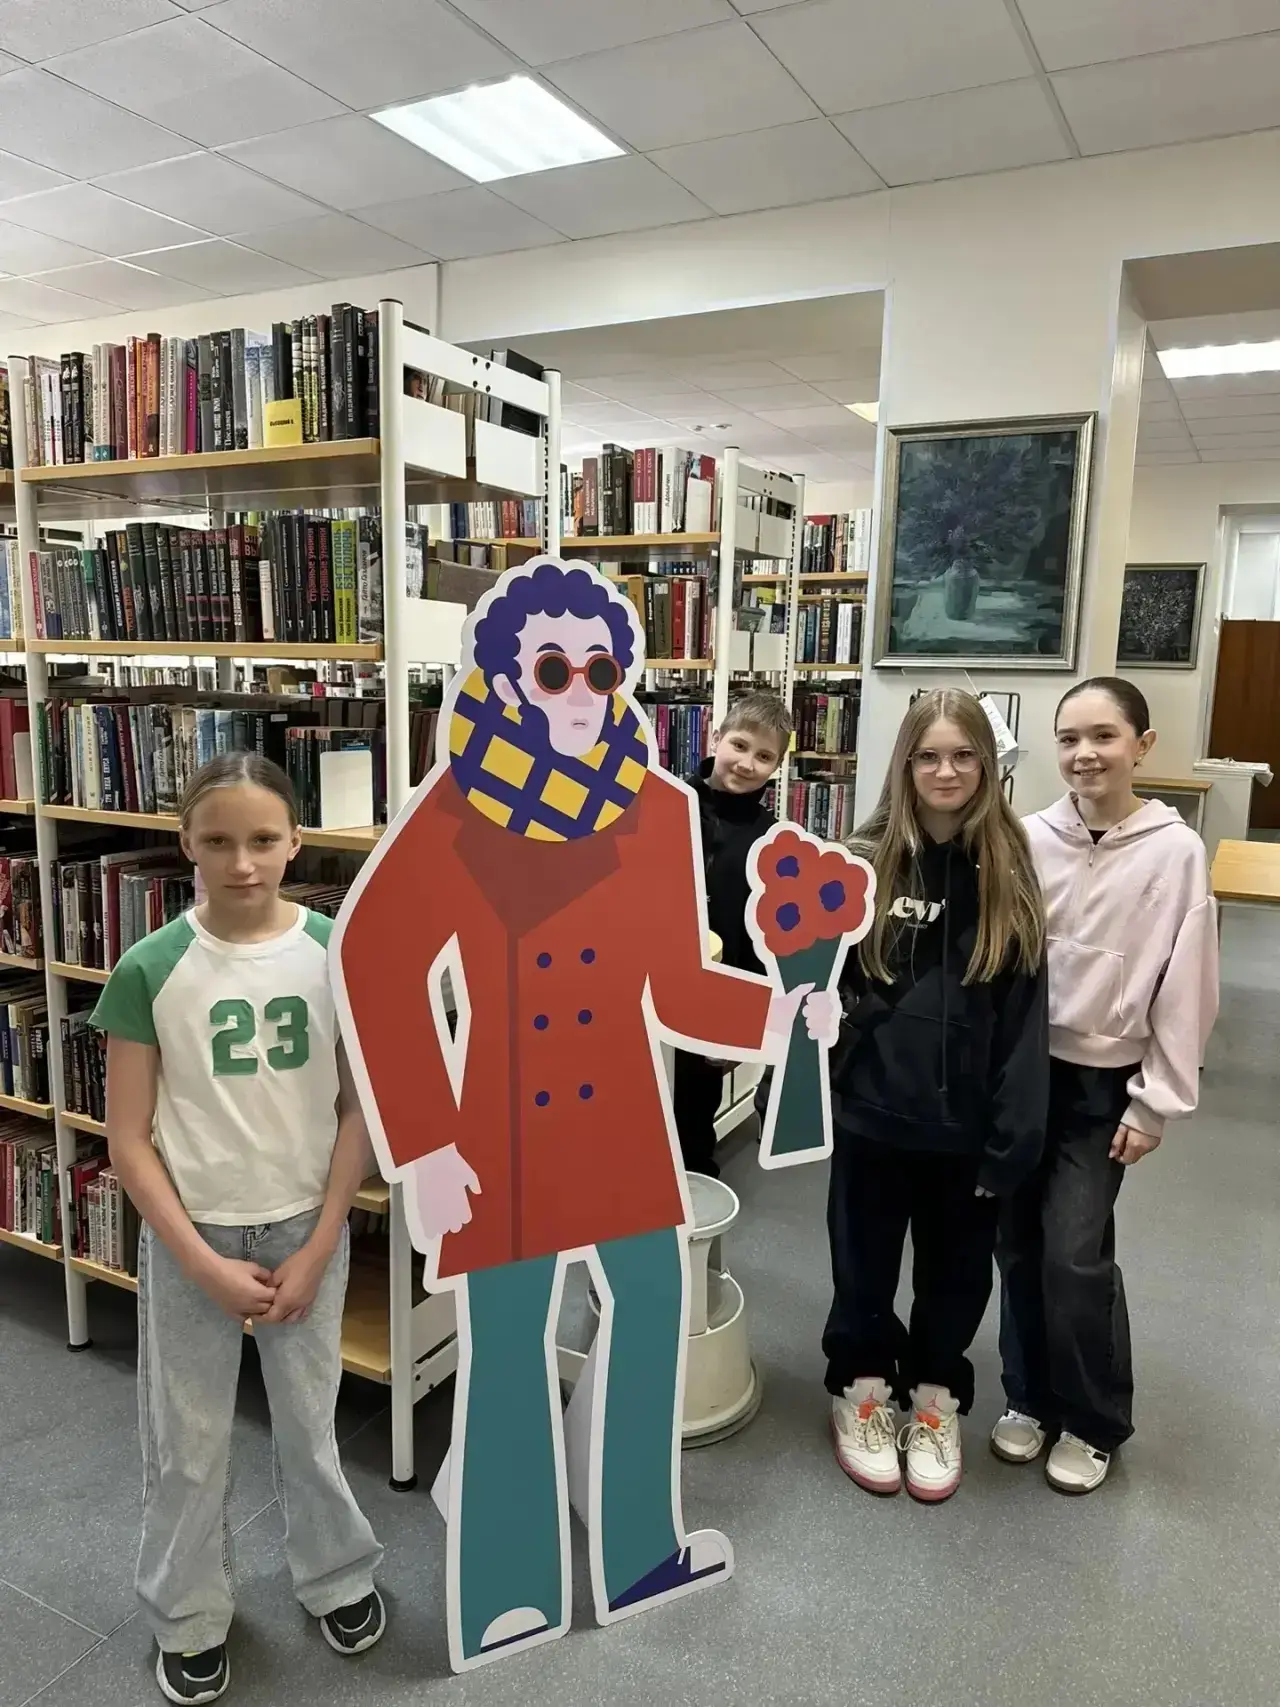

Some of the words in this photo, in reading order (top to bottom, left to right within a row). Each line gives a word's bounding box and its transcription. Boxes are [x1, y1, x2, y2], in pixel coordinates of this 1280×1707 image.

[111, 560, 119, 593] ВЫСОЦКИЙ
[343, 528, 353, 590] БЭСТОЛОЧЬ
[115, 594, 123, 626] ВЛАДИМИР
[209, 995, 310, 1076] 23
